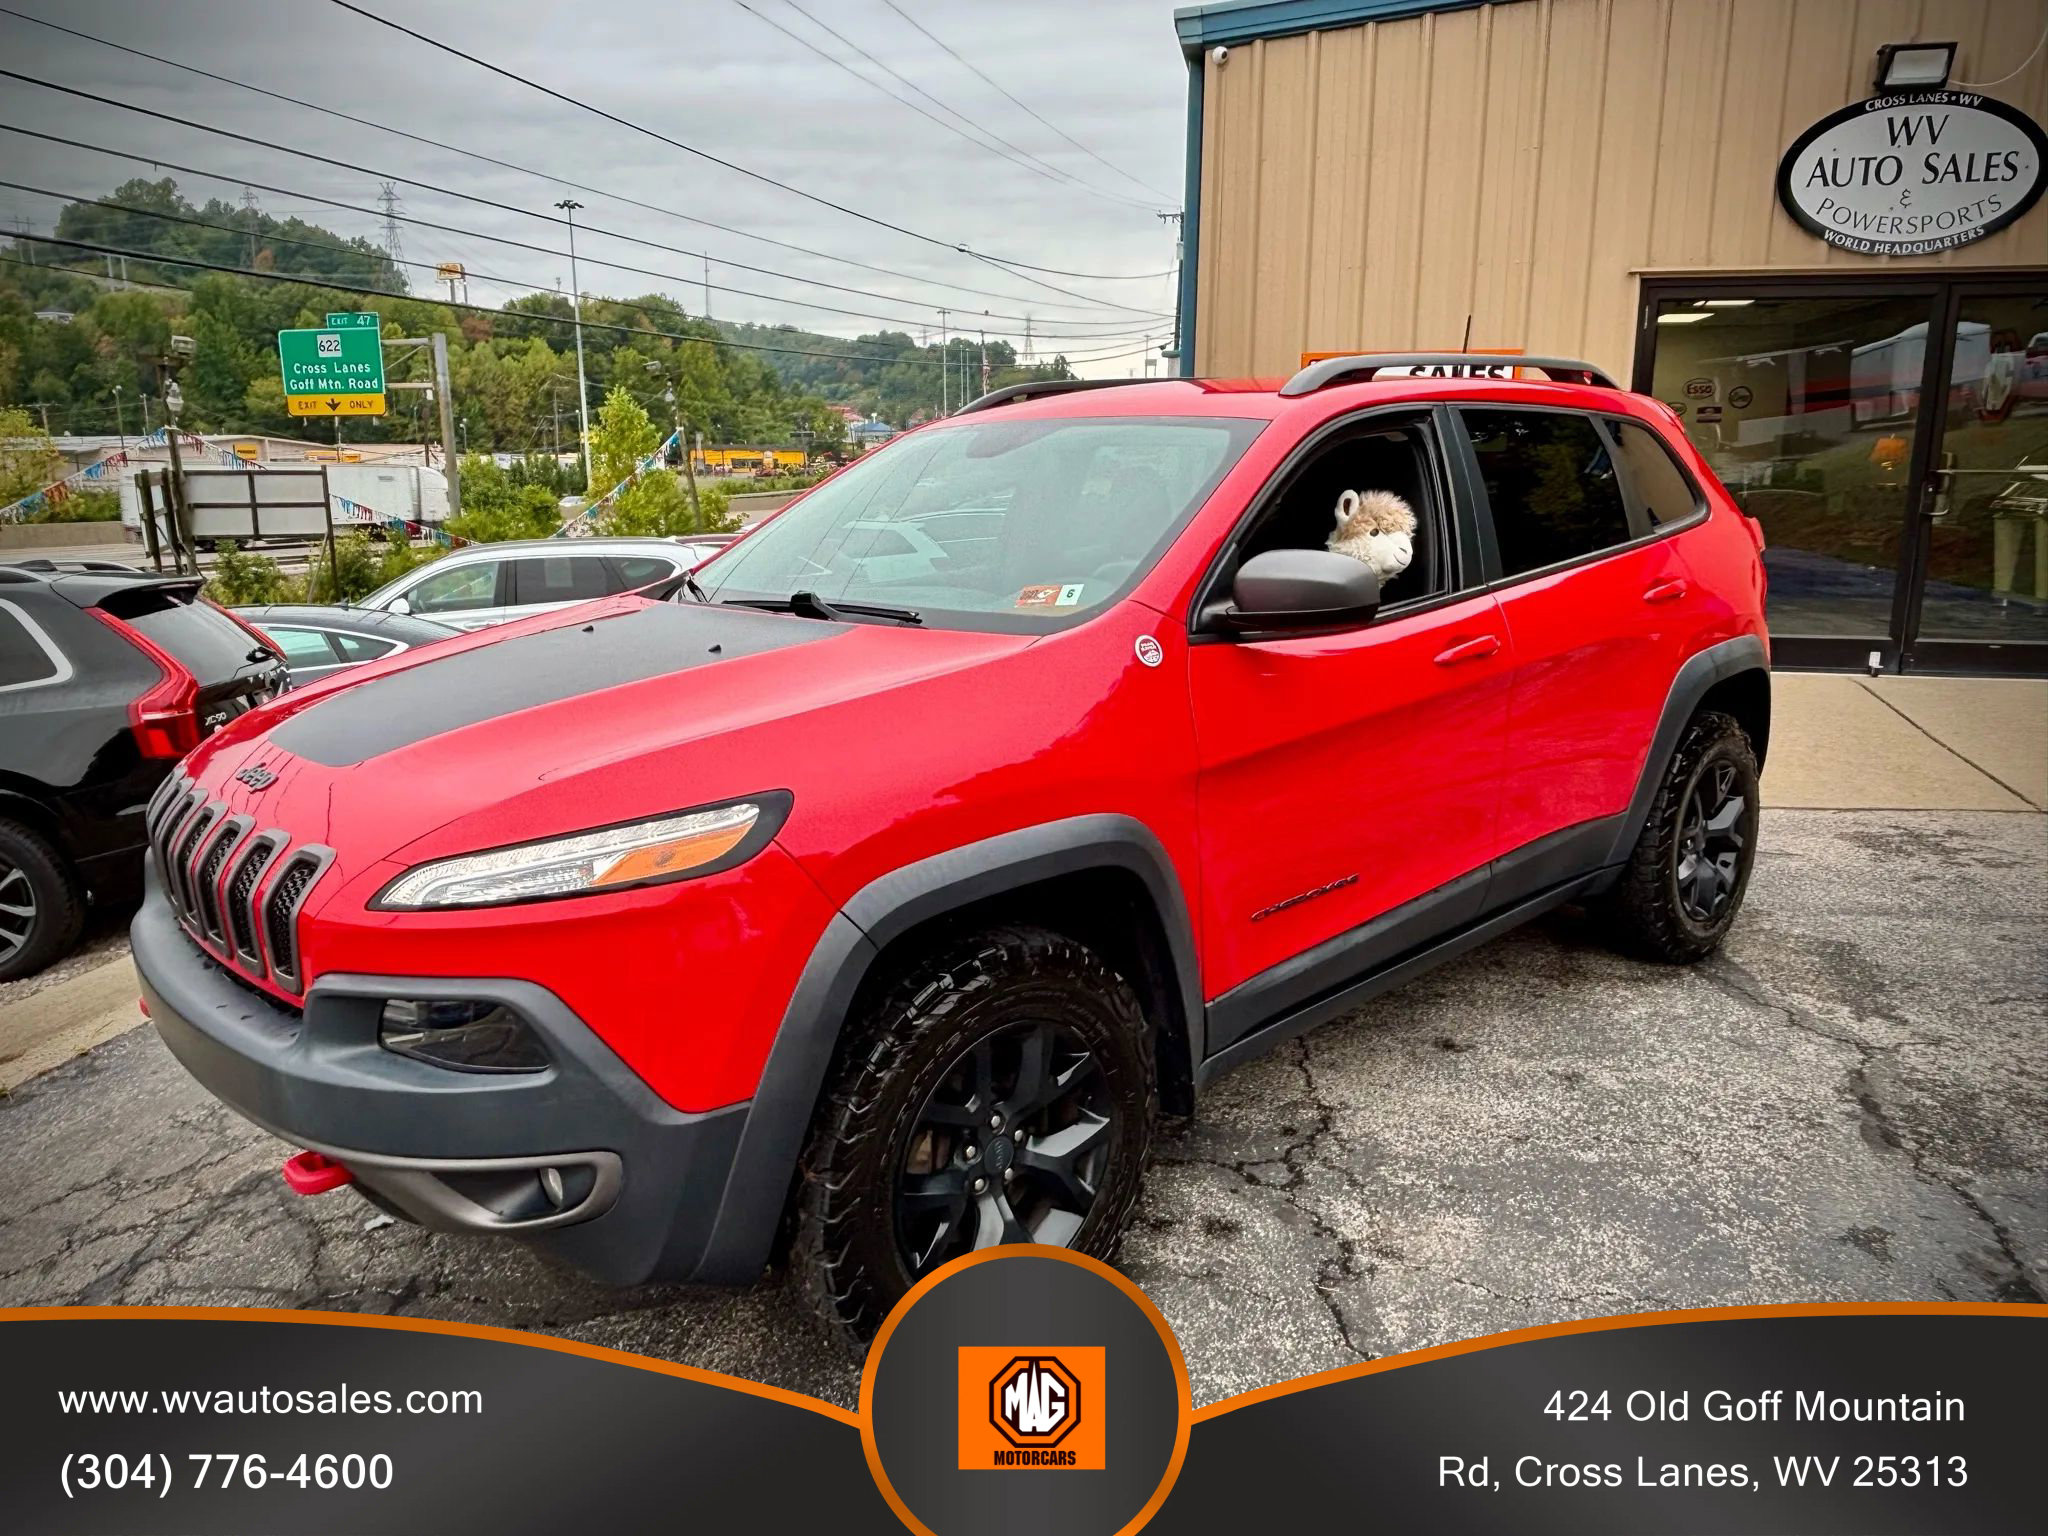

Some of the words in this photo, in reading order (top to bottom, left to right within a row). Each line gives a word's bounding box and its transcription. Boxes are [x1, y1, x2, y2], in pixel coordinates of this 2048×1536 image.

[1865, 94, 1906, 112] CROSS
[1909, 92, 1949, 104] LANES
[1958, 94, 1984, 107] WV
[1887, 114, 1950, 147] WV
[1805, 155, 1904, 188] AUTO
[1921, 151, 2020, 185] SALES
[1898, 188, 1912, 209] &
[1815, 194, 2003, 236] POWERSPORTS
[1823, 229, 1871, 252] WORLD
[1873, 225, 1986, 256] HEADQUARTERS
[331, 317, 348, 326] EXIT
[356, 315, 371, 326] 47
[319, 339, 341, 353] 622
[293, 362, 327, 374] Cross
[333, 361, 371, 373] Lanes
[289, 378, 314, 391] Goff
[318, 378, 345, 390] Mtn.
[348, 377, 379, 389] Road
[297, 400, 318, 410] EXIT
[349, 400, 374, 409] ONLY
[1066, 588, 1075, 598] 6
